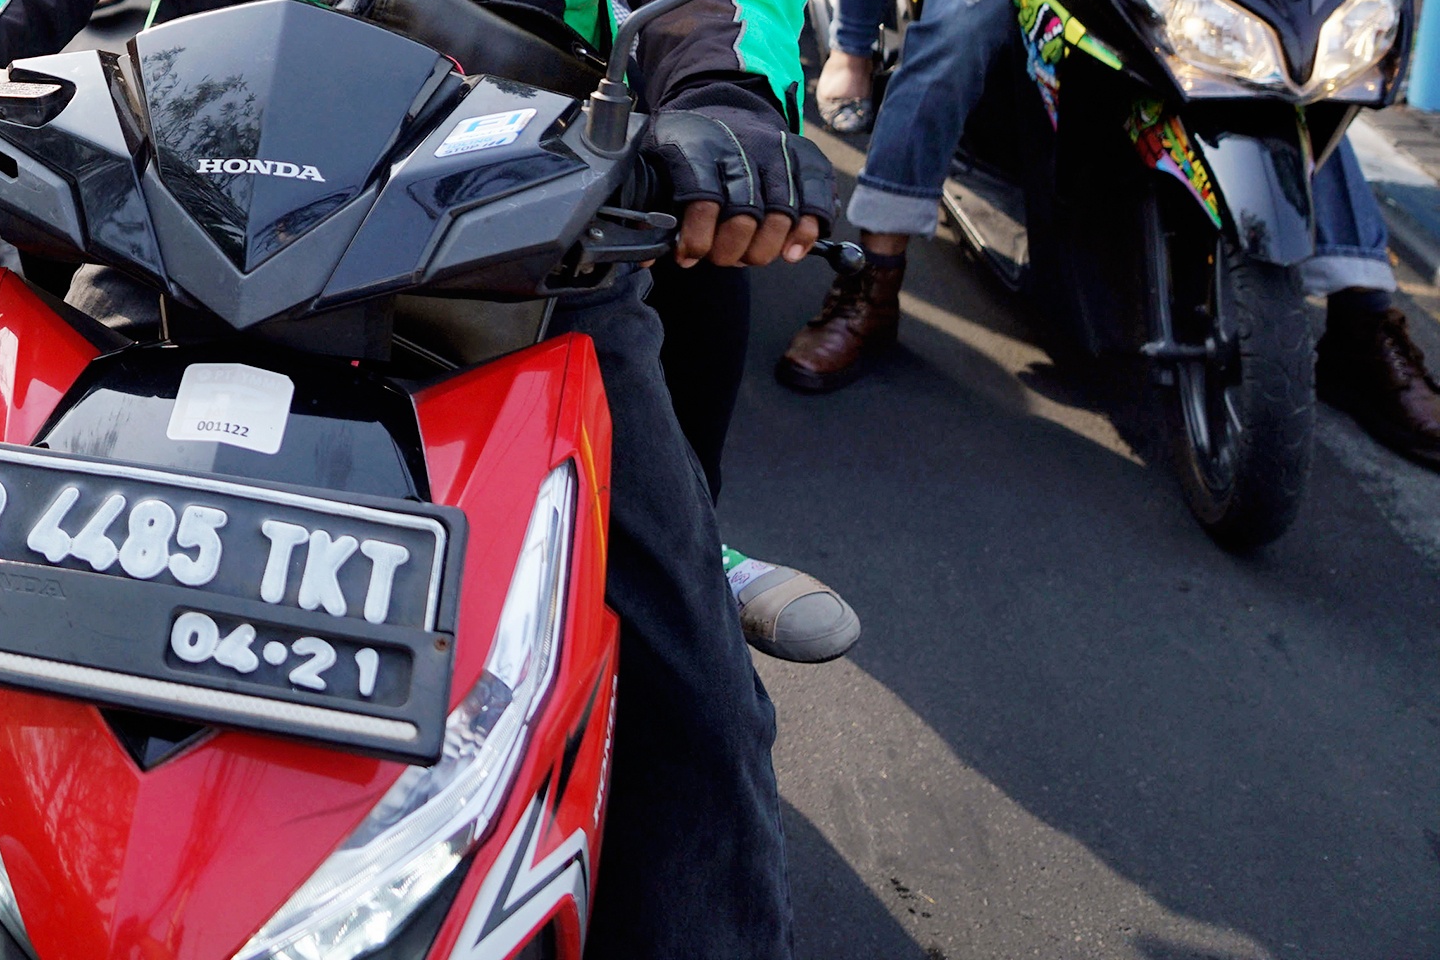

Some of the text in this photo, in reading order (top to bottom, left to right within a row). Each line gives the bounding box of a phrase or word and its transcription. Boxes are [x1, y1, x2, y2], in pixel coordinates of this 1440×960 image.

[196, 158, 326, 182] HONDA
[197, 420, 250, 438] 001122
[26, 486, 229, 586] 4485
[260, 520, 410, 624] TKT
